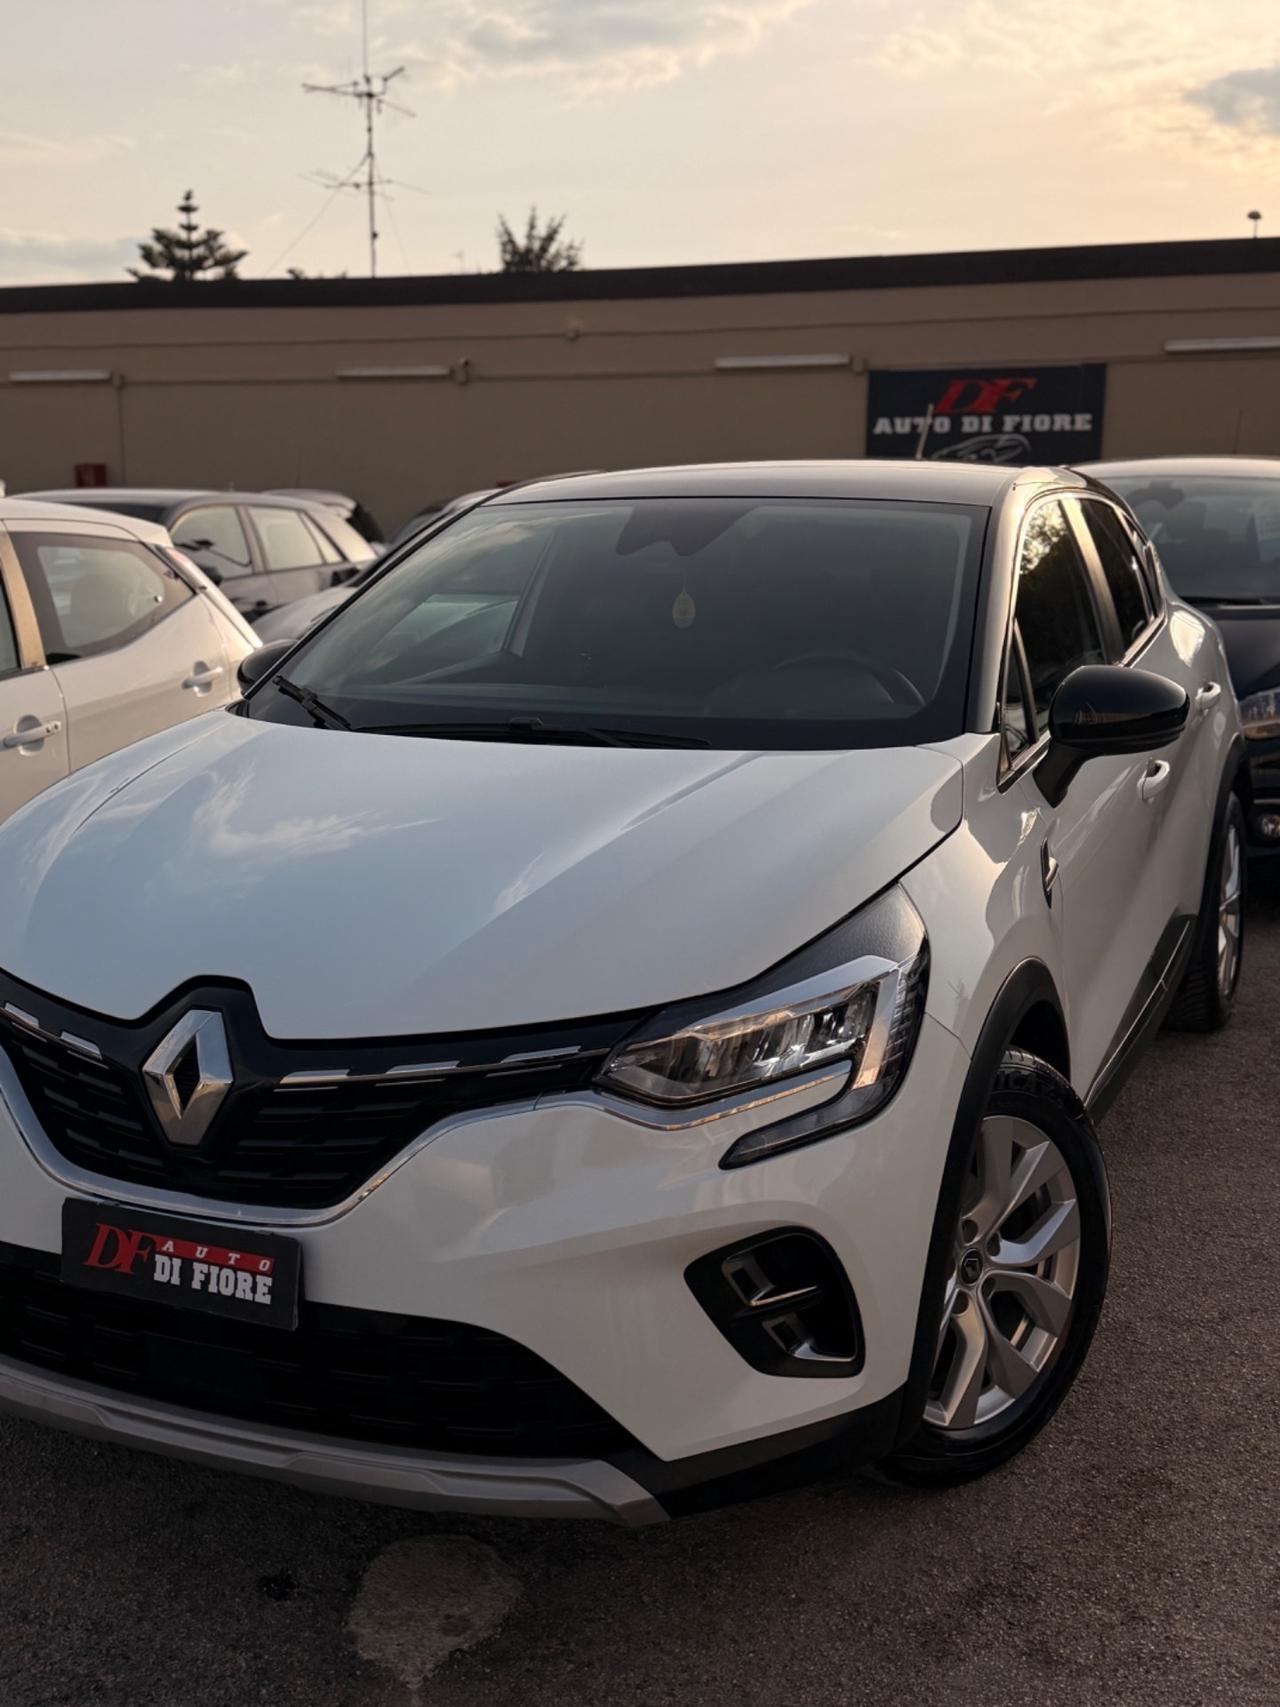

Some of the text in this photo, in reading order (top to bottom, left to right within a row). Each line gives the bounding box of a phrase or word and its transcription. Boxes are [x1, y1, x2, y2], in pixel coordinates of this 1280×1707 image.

[933, 377, 1038, 413] DF
[873, 413, 1092, 434] AUTO DI FIORE
[83, 1223, 151, 1274] DF
[154, 1254, 273, 1304] DI FIORE
